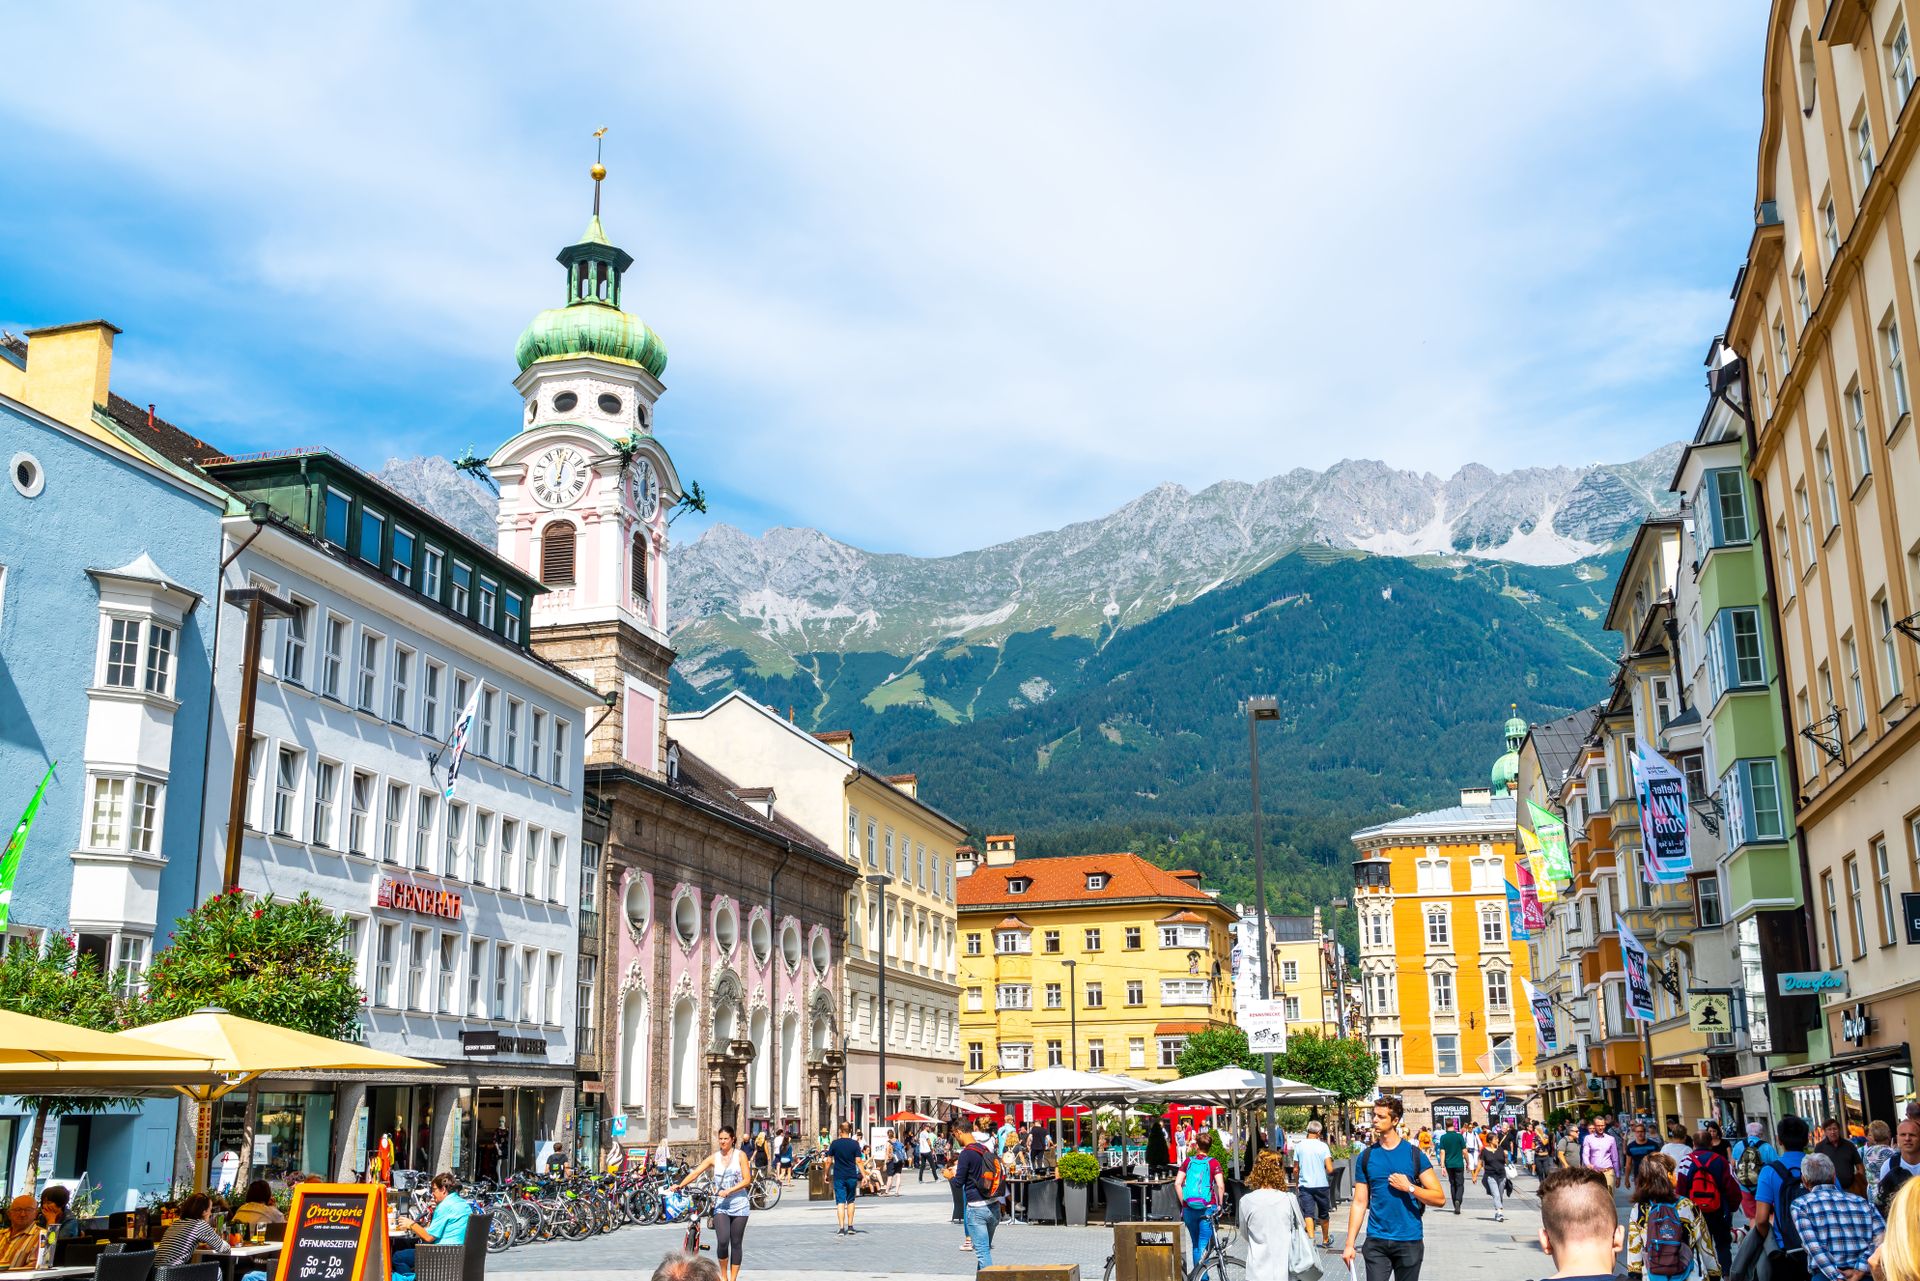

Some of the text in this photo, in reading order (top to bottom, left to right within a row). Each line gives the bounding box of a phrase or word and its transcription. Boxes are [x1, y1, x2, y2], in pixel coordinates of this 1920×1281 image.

[1784, 972, 1842, 993] Douglas
[196, 1107, 206, 1159] BURGERS
[306, 1204, 363, 1222] Orangerie
[299, 1238, 358, 1248] ÖFFNUNGSZEITEN
[306, 1256, 318, 1266] So
[329, 1256, 342, 1266] Do
